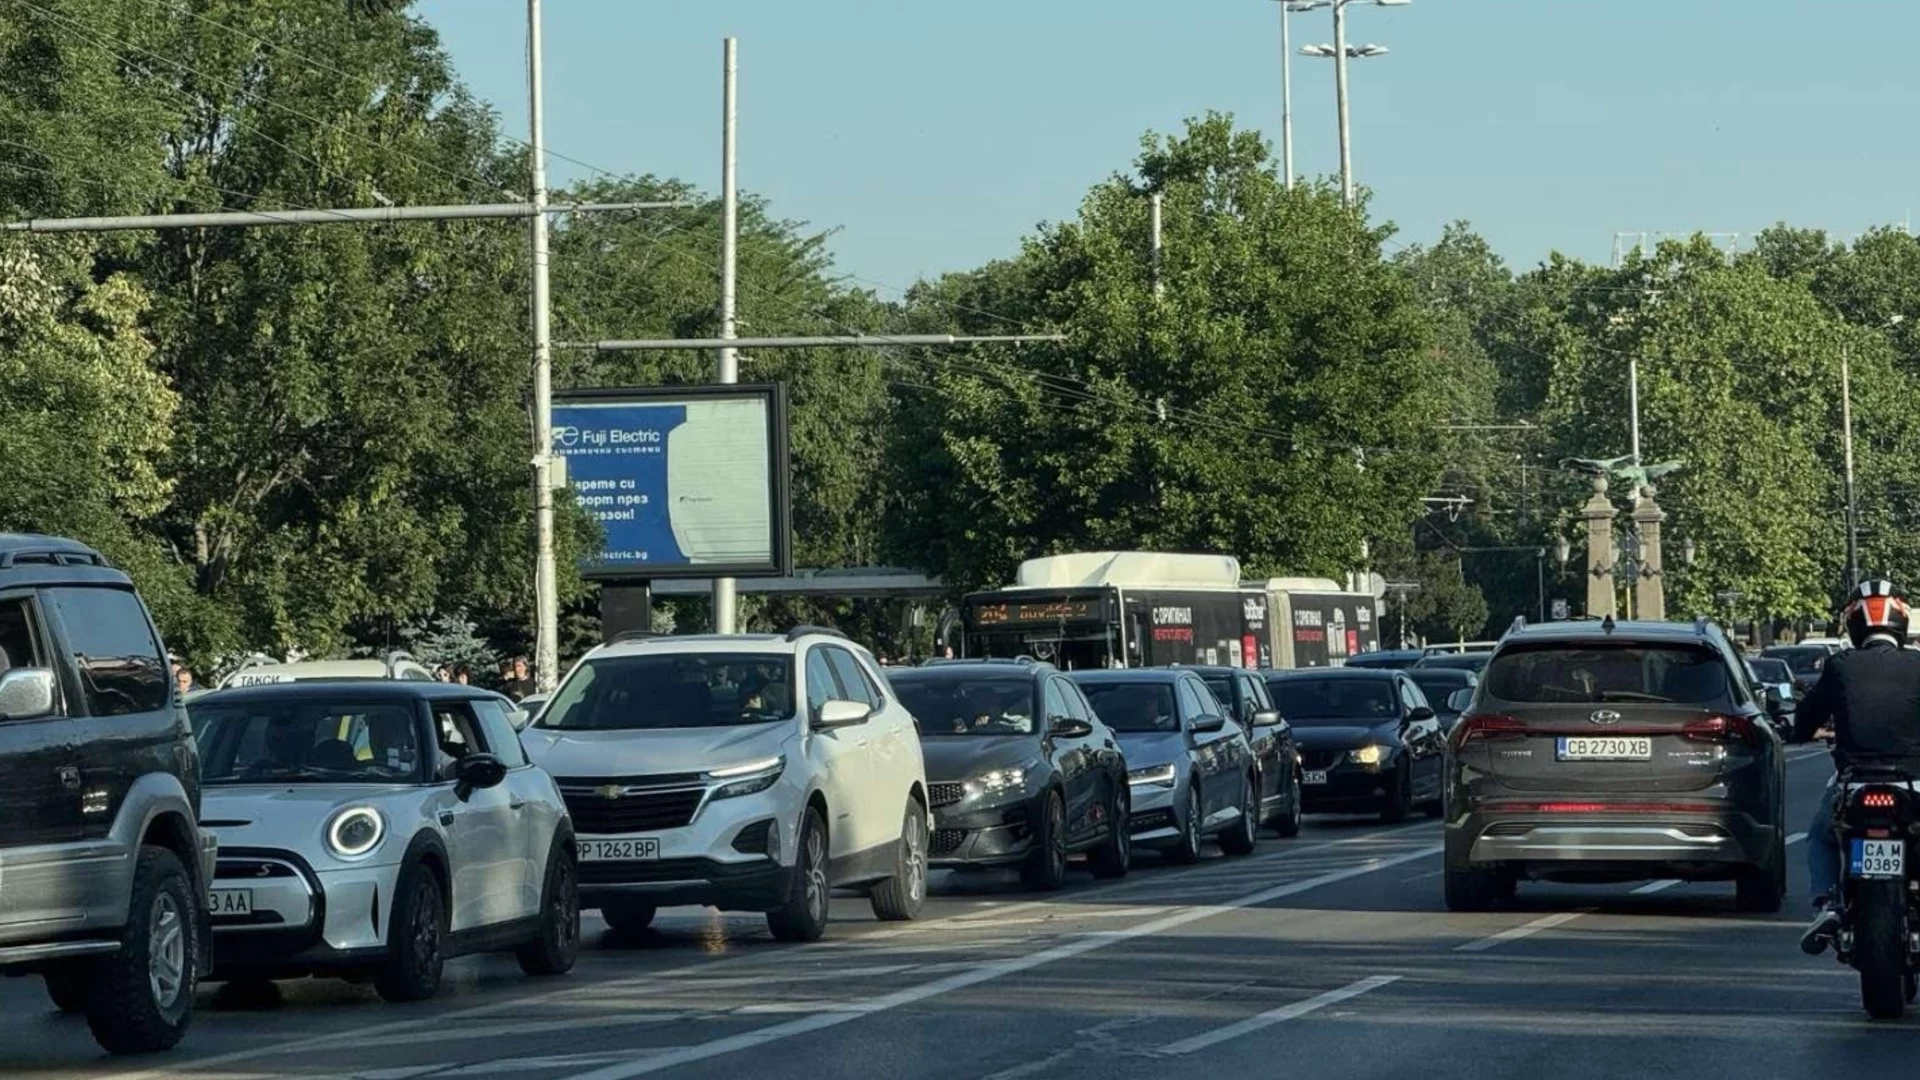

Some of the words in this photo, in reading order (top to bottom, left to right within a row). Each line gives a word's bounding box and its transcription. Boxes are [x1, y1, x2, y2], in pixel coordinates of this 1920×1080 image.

[582, 429, 607, 447] Fuji
[610, 429, 661, 443] Electric
[620, 480, 635, 489] си
[617, 495, 648, 507] през
[241, 675, 280, 688] ТАКСИ
[1568, 740, 1587, 754] CB
[1590, 740, 1626, 754] 2730
[1629, 740, 1648, 754] XB
[596, 842, 632, 858] 1262
[634, 841, 656, 857] BP
[1864, 843, 1885, 857] CA
[1891, 844, 1901, 857] M
[1864, 858, 1901, 871] 0389
[223, 893, 247, 912] AA
